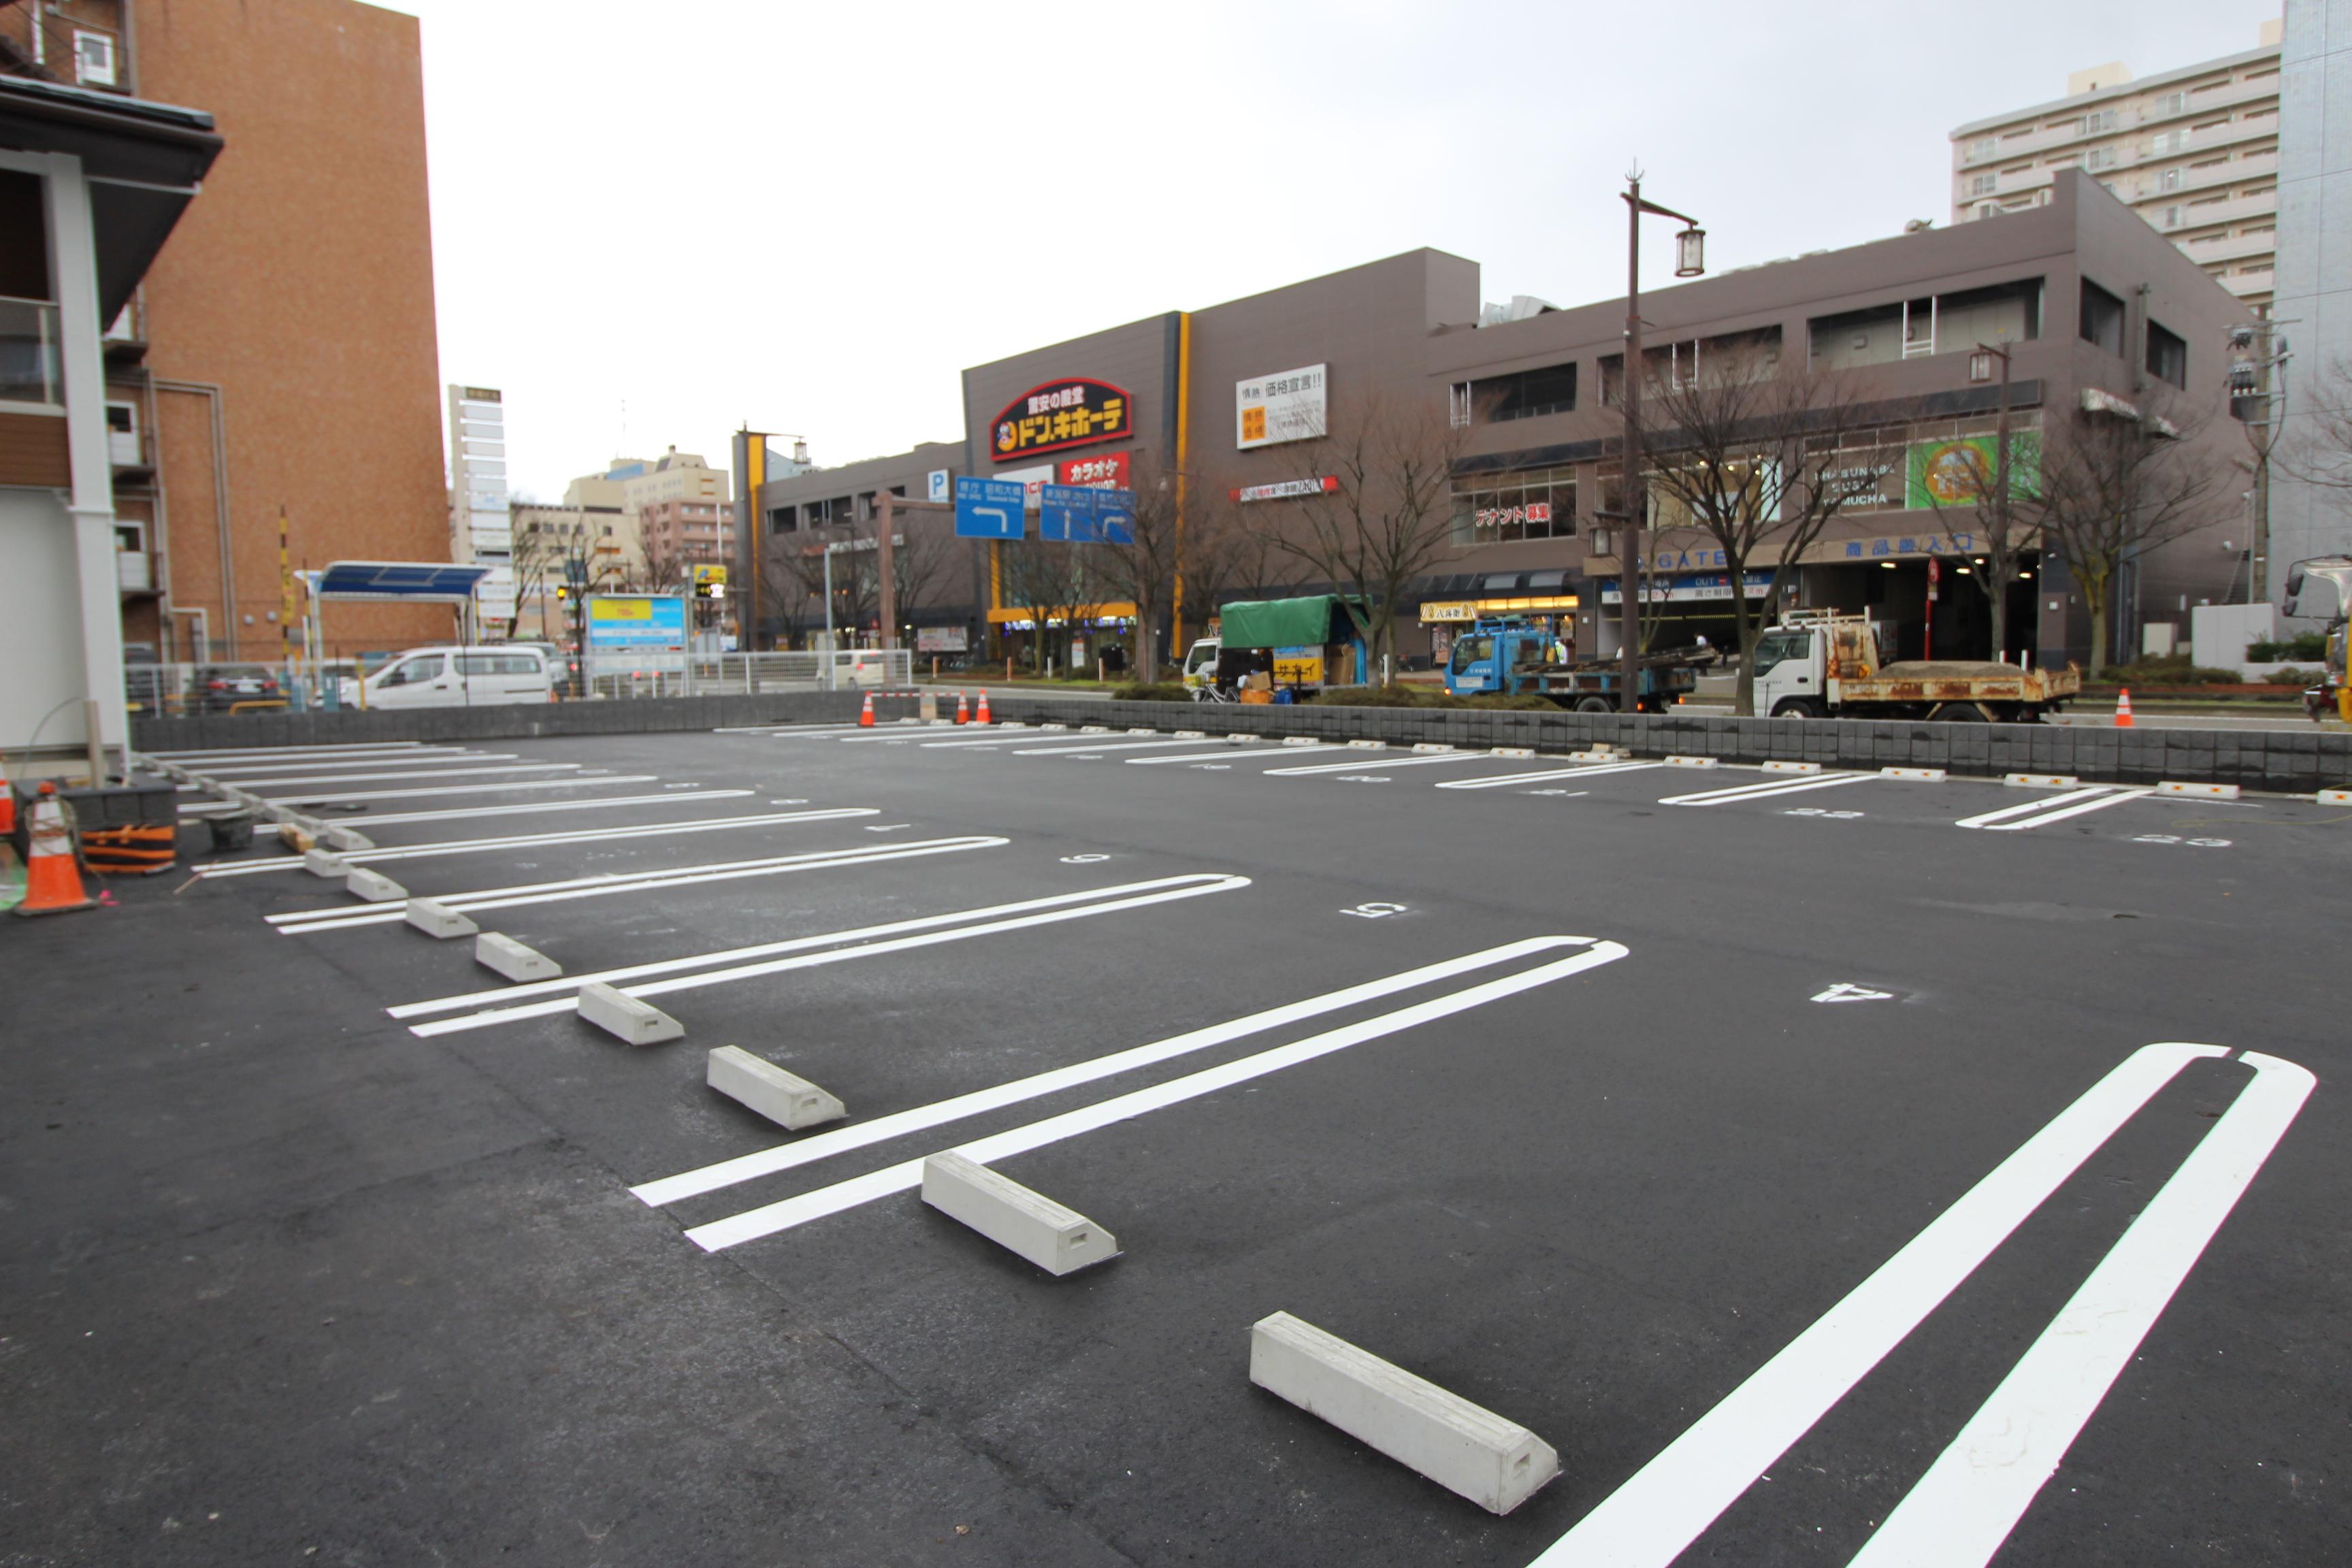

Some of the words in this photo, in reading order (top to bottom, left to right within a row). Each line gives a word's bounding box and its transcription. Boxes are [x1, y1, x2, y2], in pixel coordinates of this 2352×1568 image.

[1071, 459, 1119, 483] カラオケ
[933, 474, 944, 495] P
[1475, 502, 1550, 527] テナント募集
[1658, 550, 1727, 571] GATE
[1809, 982, 1894, 1003] 4
